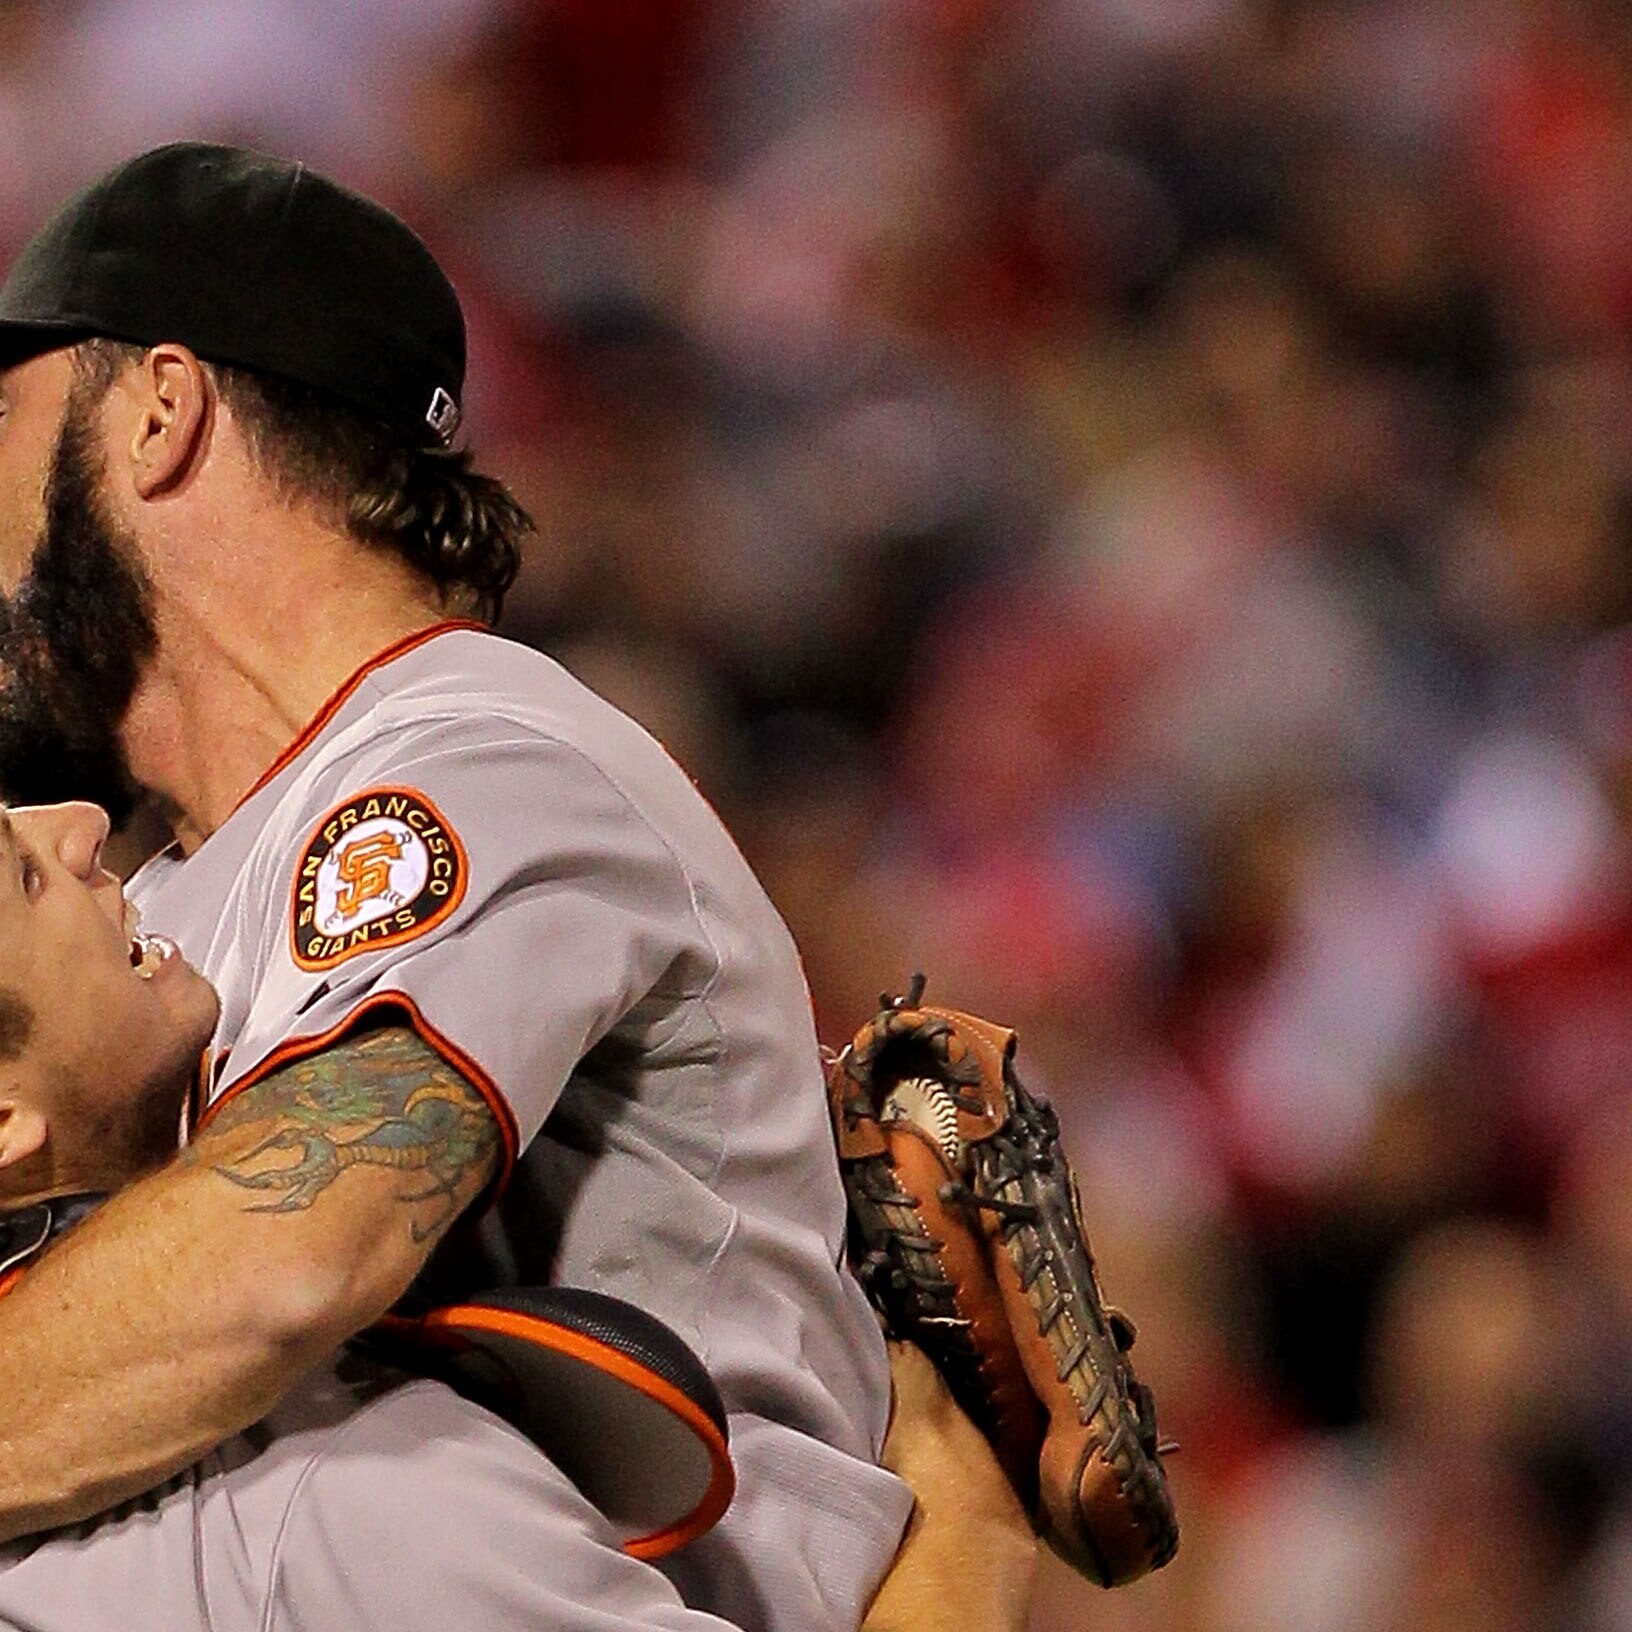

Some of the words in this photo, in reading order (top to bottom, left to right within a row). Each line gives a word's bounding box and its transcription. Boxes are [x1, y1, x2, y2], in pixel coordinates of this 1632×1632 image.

[299, 855, 322, 927] SAN
[323, 797, 452, 896] FRANCISCO
[307, 908, 416, 958] GIANTS
